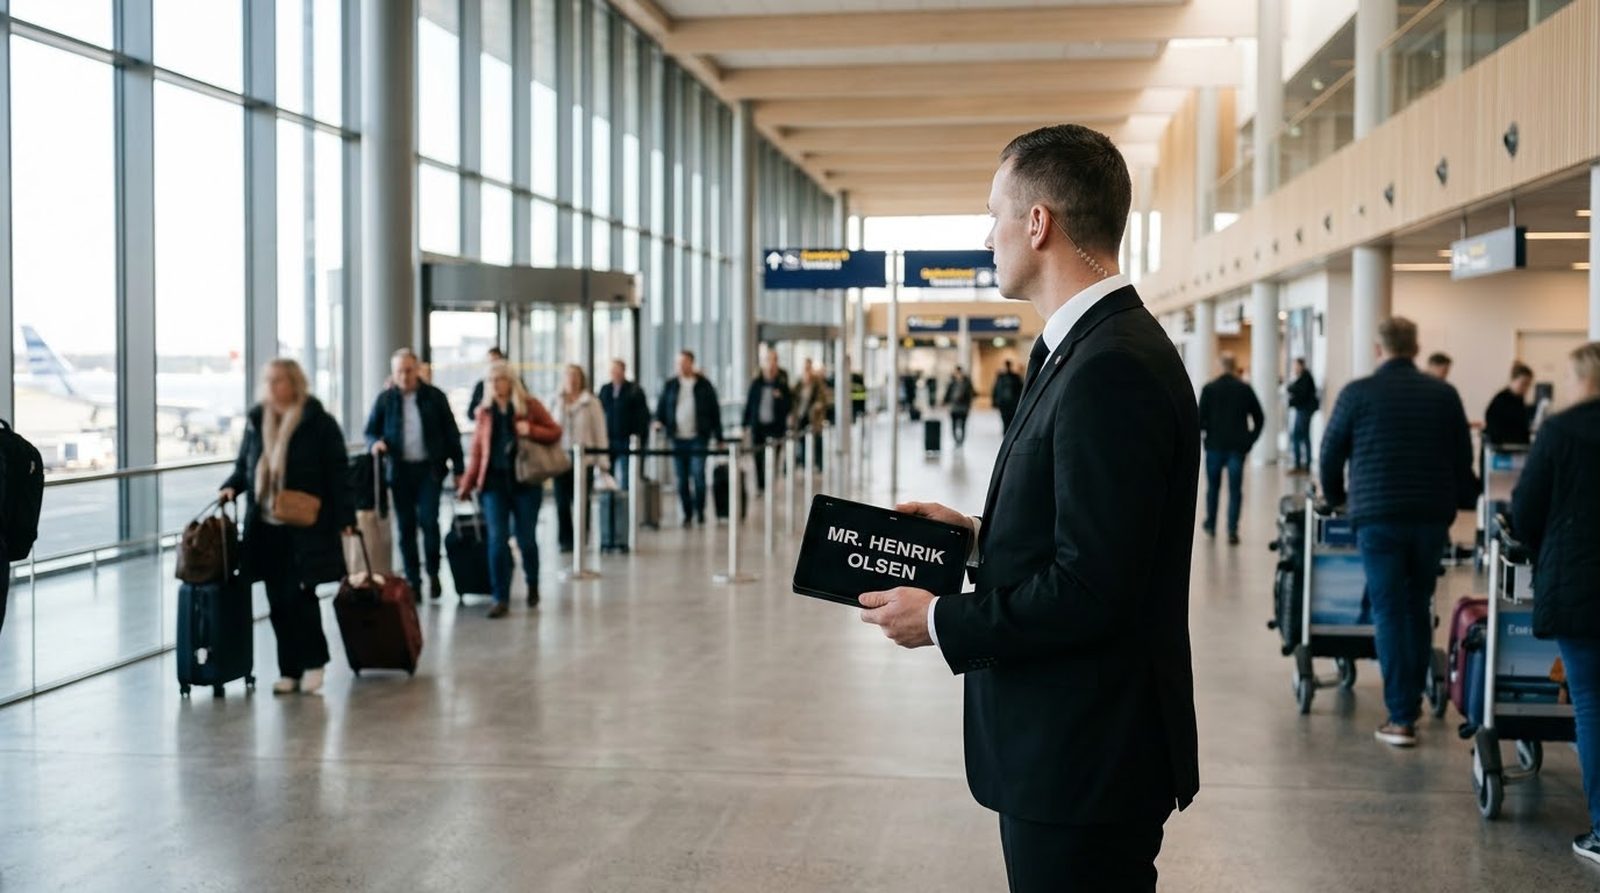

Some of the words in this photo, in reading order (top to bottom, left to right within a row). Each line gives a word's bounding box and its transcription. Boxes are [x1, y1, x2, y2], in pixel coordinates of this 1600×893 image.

[827, 526, 862, 547] MR.
[869, 535, 945, 565] HENRIK
[847, 553, 916, 580] OLSEN
